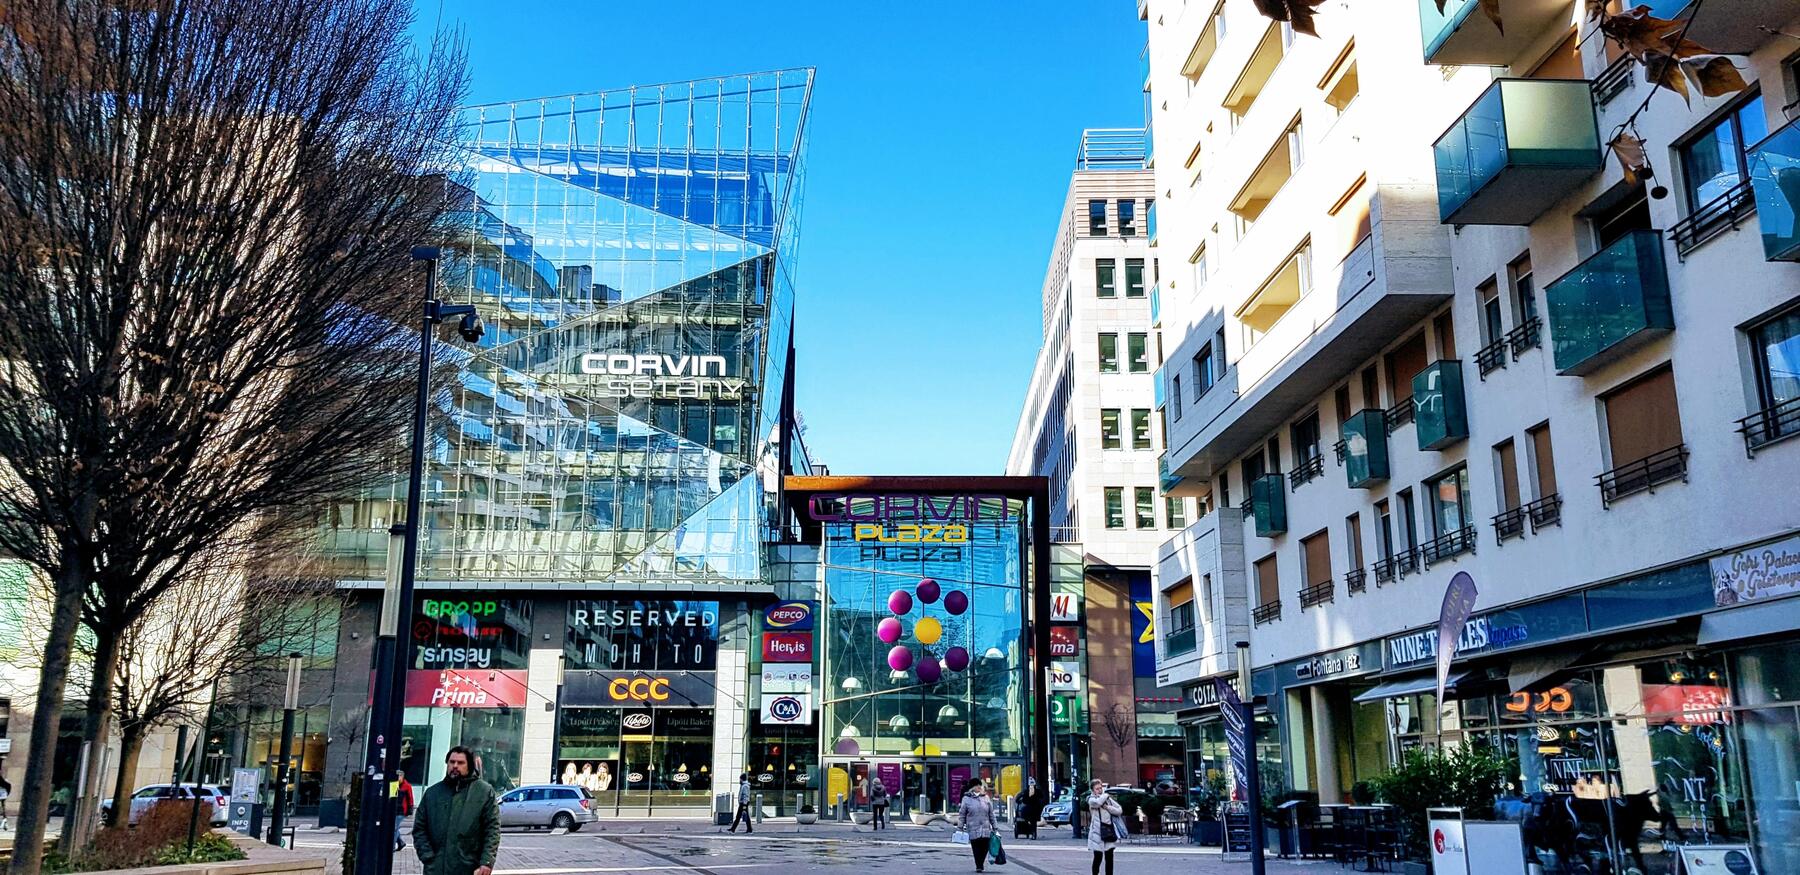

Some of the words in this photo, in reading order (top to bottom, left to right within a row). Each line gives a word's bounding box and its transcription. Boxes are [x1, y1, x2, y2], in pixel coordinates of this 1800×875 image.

[582, 354, 726, 376] CORVIN
[809, 493, 1007, 521] CORVIN
[855, 523, 967, 542] PLAZA
[575, 610, 716, 626] RESERVED
[773, 611, 804, 620] PEPCO
[771, 640, 806, 655] Hervis
[1390, 633, 1427, 665] NINE
[1426, 618, 1488, 657] TLES
[423, 643, 492, 668] sinsay
[585, 643, 702, 664] MOHTO
[1312, 658, 1342, 676] Fontana
[1051, 673, 1073, 684] NO
[608, 677, 670, 702] CCC
[1193, 684, 1216, 705] COSTA
[775, 703, 797, 715] C&A
[1682, 778, 1706, 801] NT
